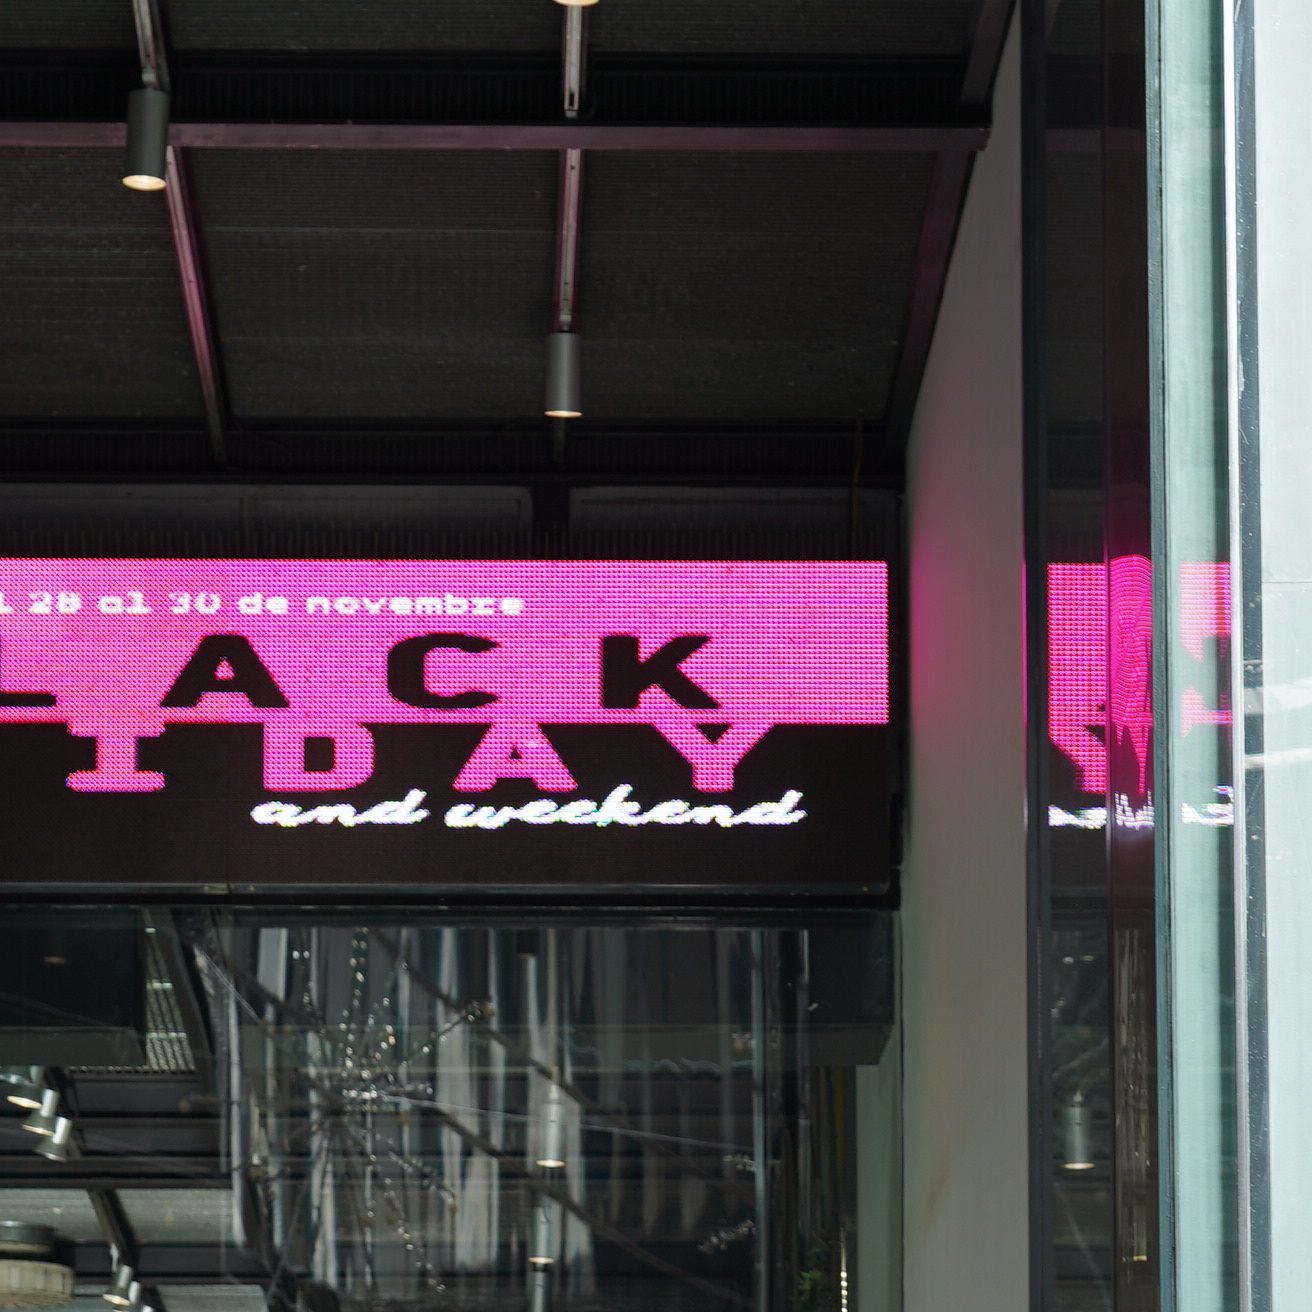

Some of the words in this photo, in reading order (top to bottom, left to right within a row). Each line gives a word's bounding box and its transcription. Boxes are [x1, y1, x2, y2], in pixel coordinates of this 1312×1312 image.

[28, 591, 83, 615] 28
[98, 590, 153, 615] al
[168, 591, 223, 615] 30
[238, 592, 290, 615] de
[307, 592, 526, 616] novembre
[251, 787, 430, 827] and
[444, 783, 808, 830] weekend
